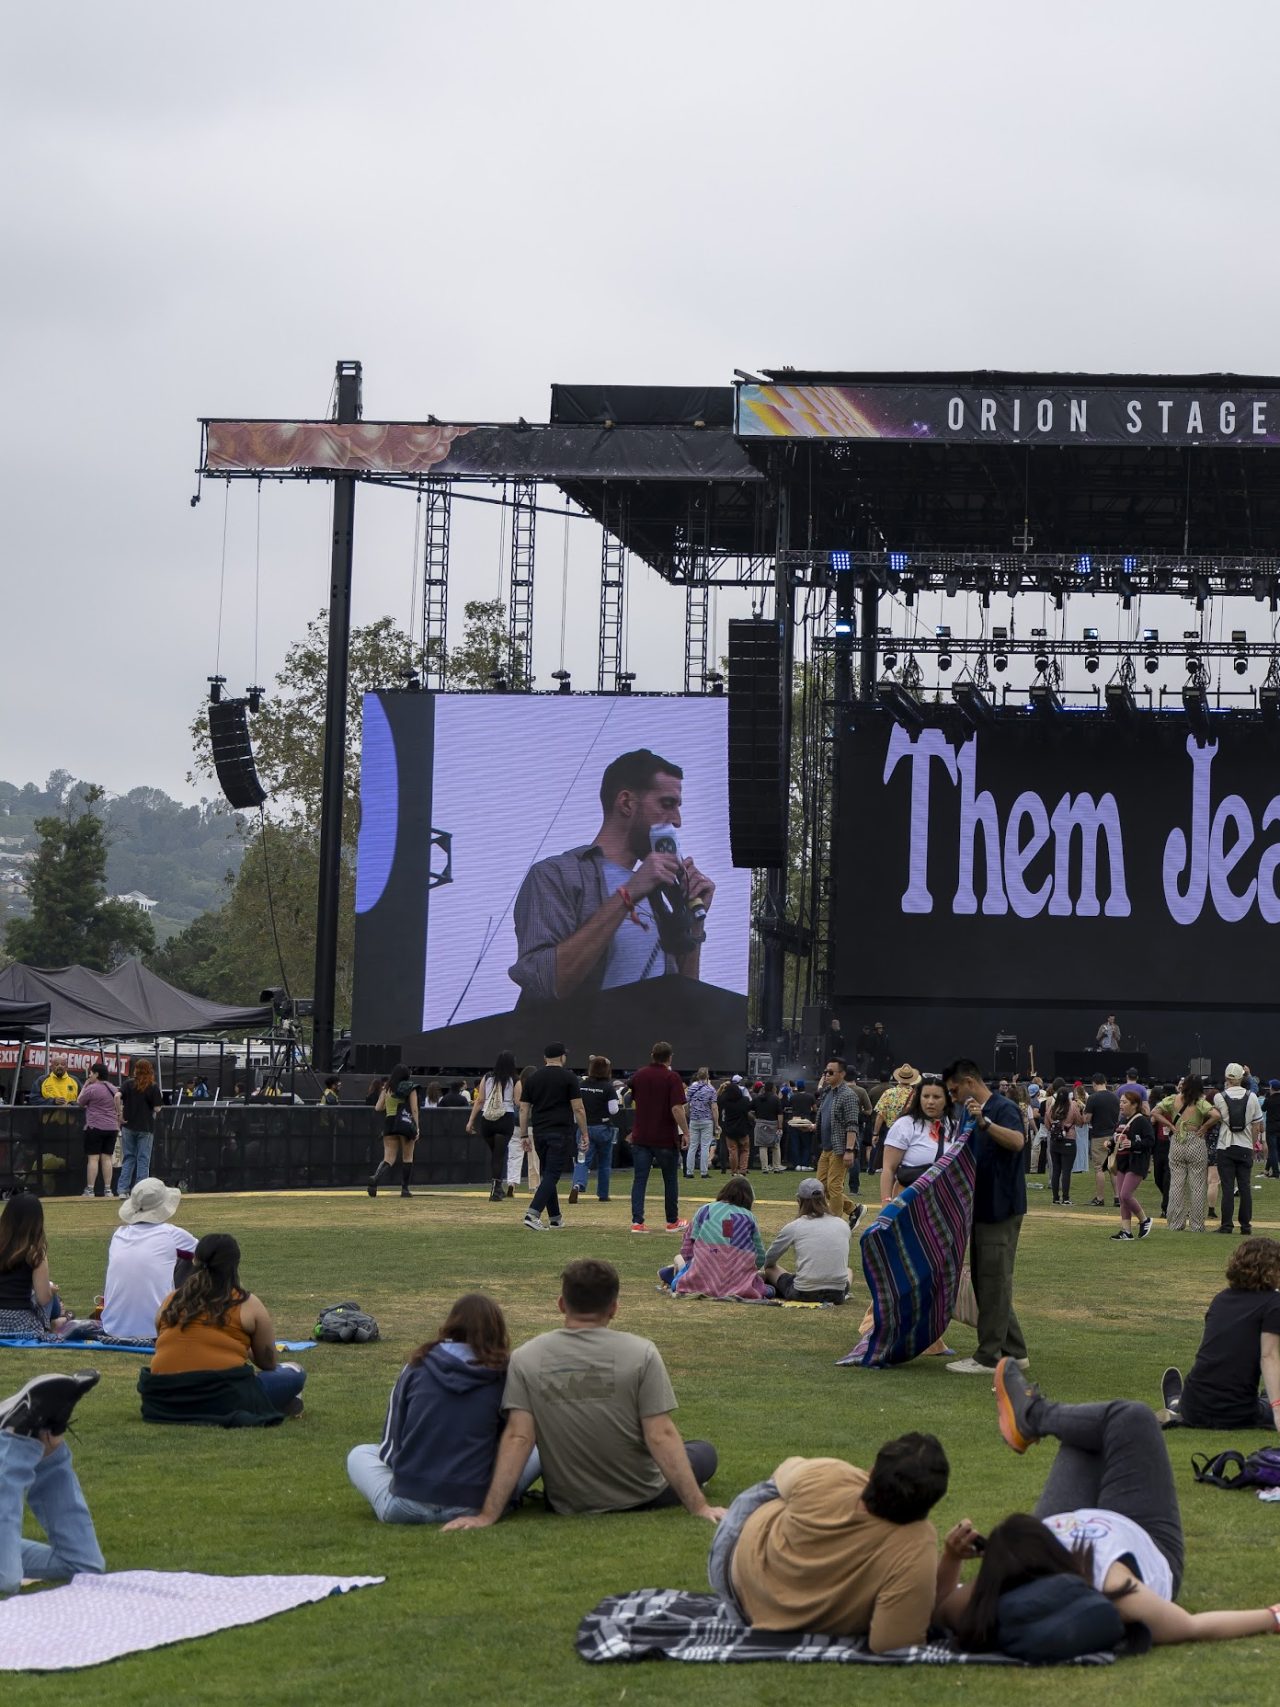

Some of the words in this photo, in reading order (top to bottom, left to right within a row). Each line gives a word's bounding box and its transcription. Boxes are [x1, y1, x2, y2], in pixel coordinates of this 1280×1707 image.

[948, 397, 1087, 432] ORION
[1126, 400, 1268, 434] STAGE
[883, 721, 1132, 918] Them
[0, 1050, 19, 1063] XIT
[104, 1056, 127, 1073] EXT
